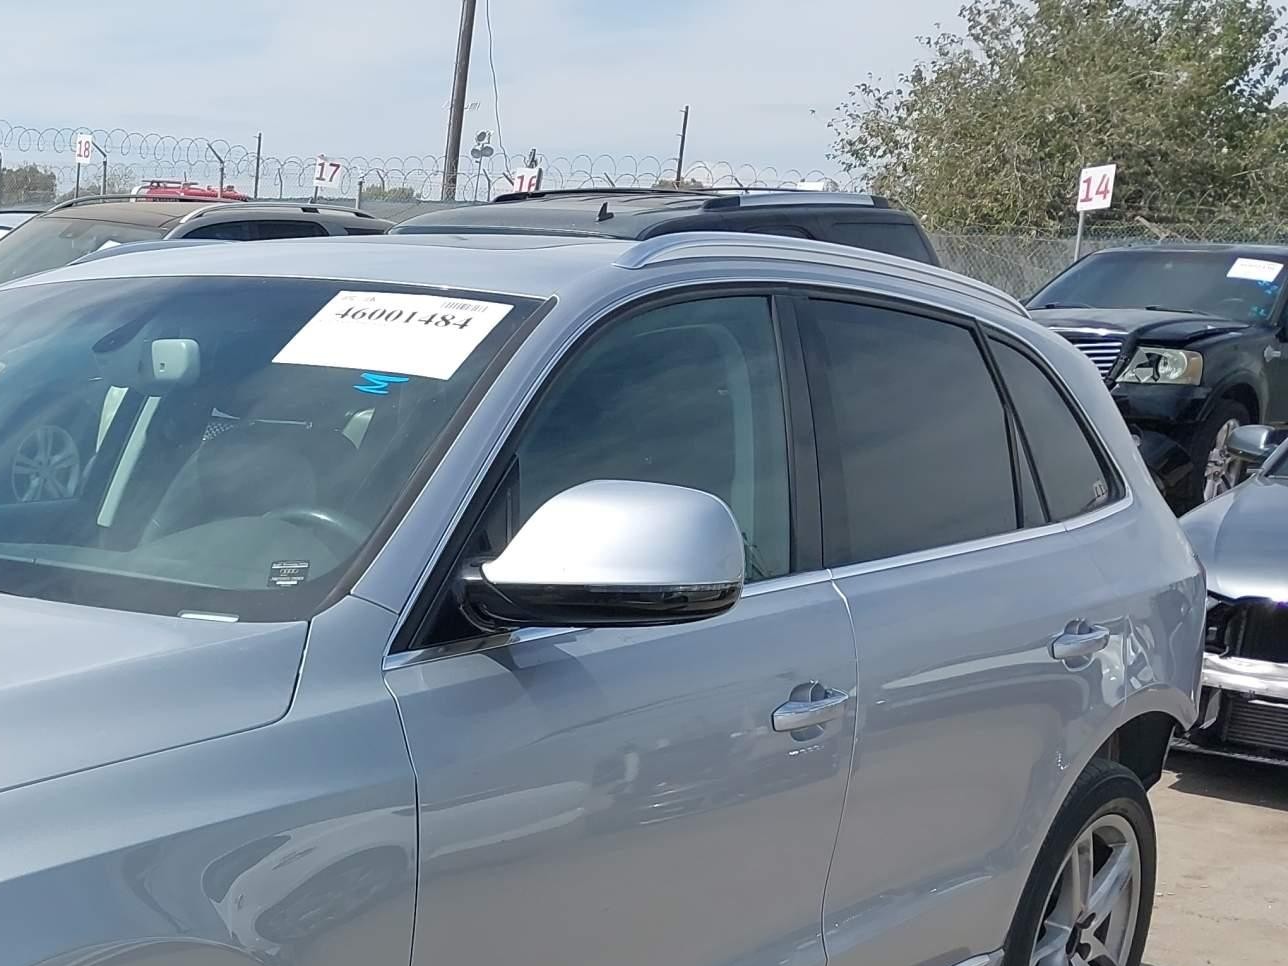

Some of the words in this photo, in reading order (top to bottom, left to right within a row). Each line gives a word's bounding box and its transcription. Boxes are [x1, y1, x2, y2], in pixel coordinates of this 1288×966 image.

[77, 139, 91, 158] 18
[315, 161, 341, 182] 17
[1080, 173, 1109, 203] 14
[335, 306, 473, 329] 46001484
